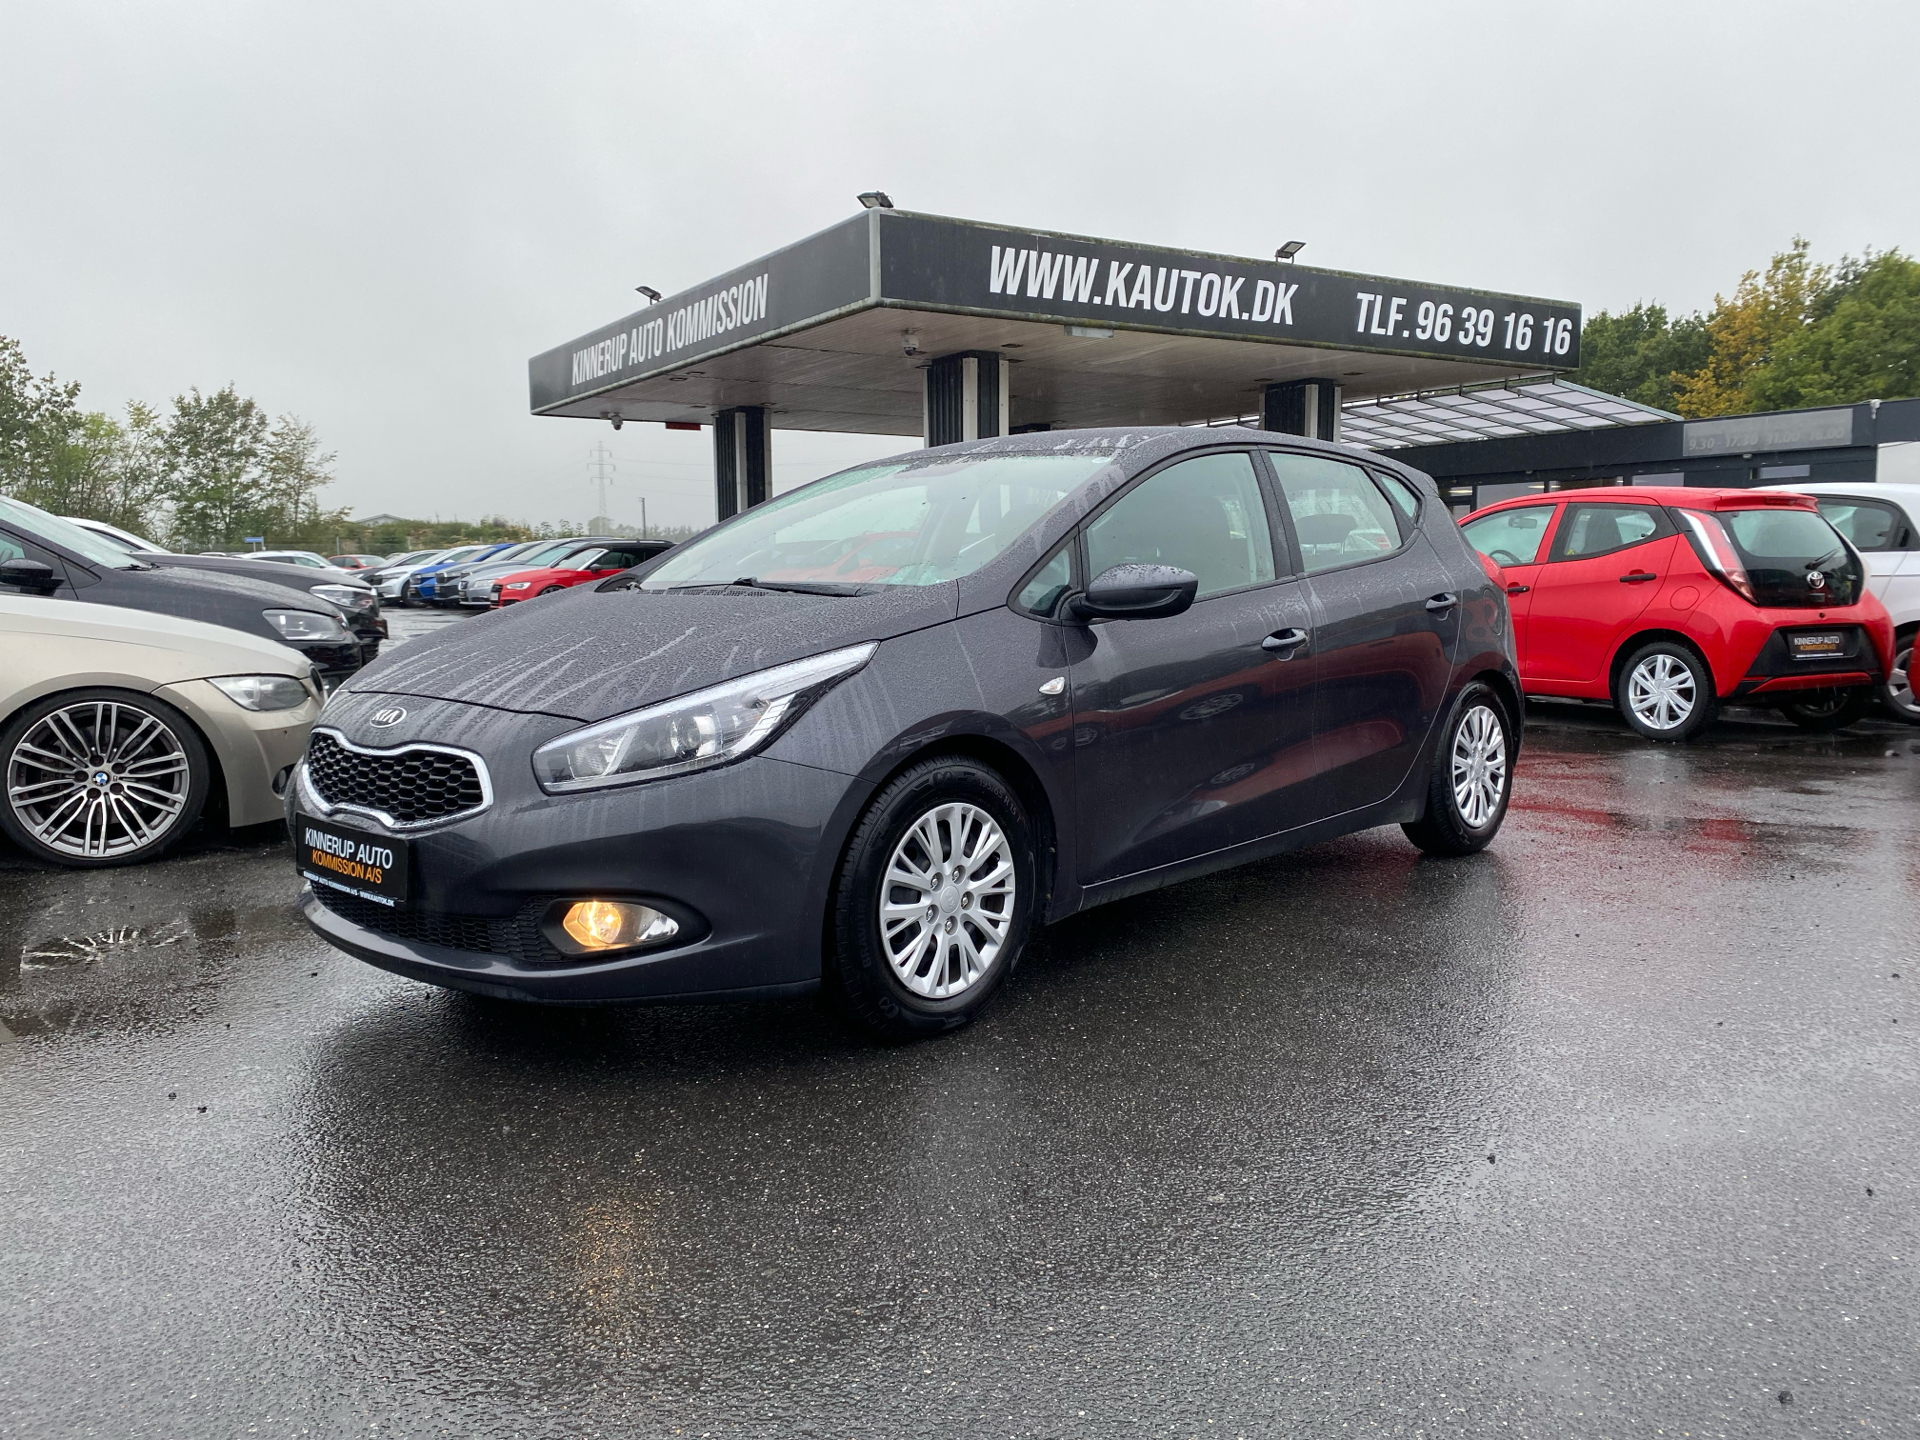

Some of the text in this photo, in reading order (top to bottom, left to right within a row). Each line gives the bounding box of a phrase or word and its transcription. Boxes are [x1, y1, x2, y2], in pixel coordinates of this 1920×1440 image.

[989, 244, 1300, 326] WWW.KAUTOK.DK
[571, 273, 769, 387] KINNERUP AUTO KOMMISSION
[1356, 291, 1573, 356] TLF. 96 39 16 16
[305, 827, 393, 870] KINNERUP AUTO
[312, 848, 364, 879] KOMMISSION
[365, 866, 382, 884] A/S
